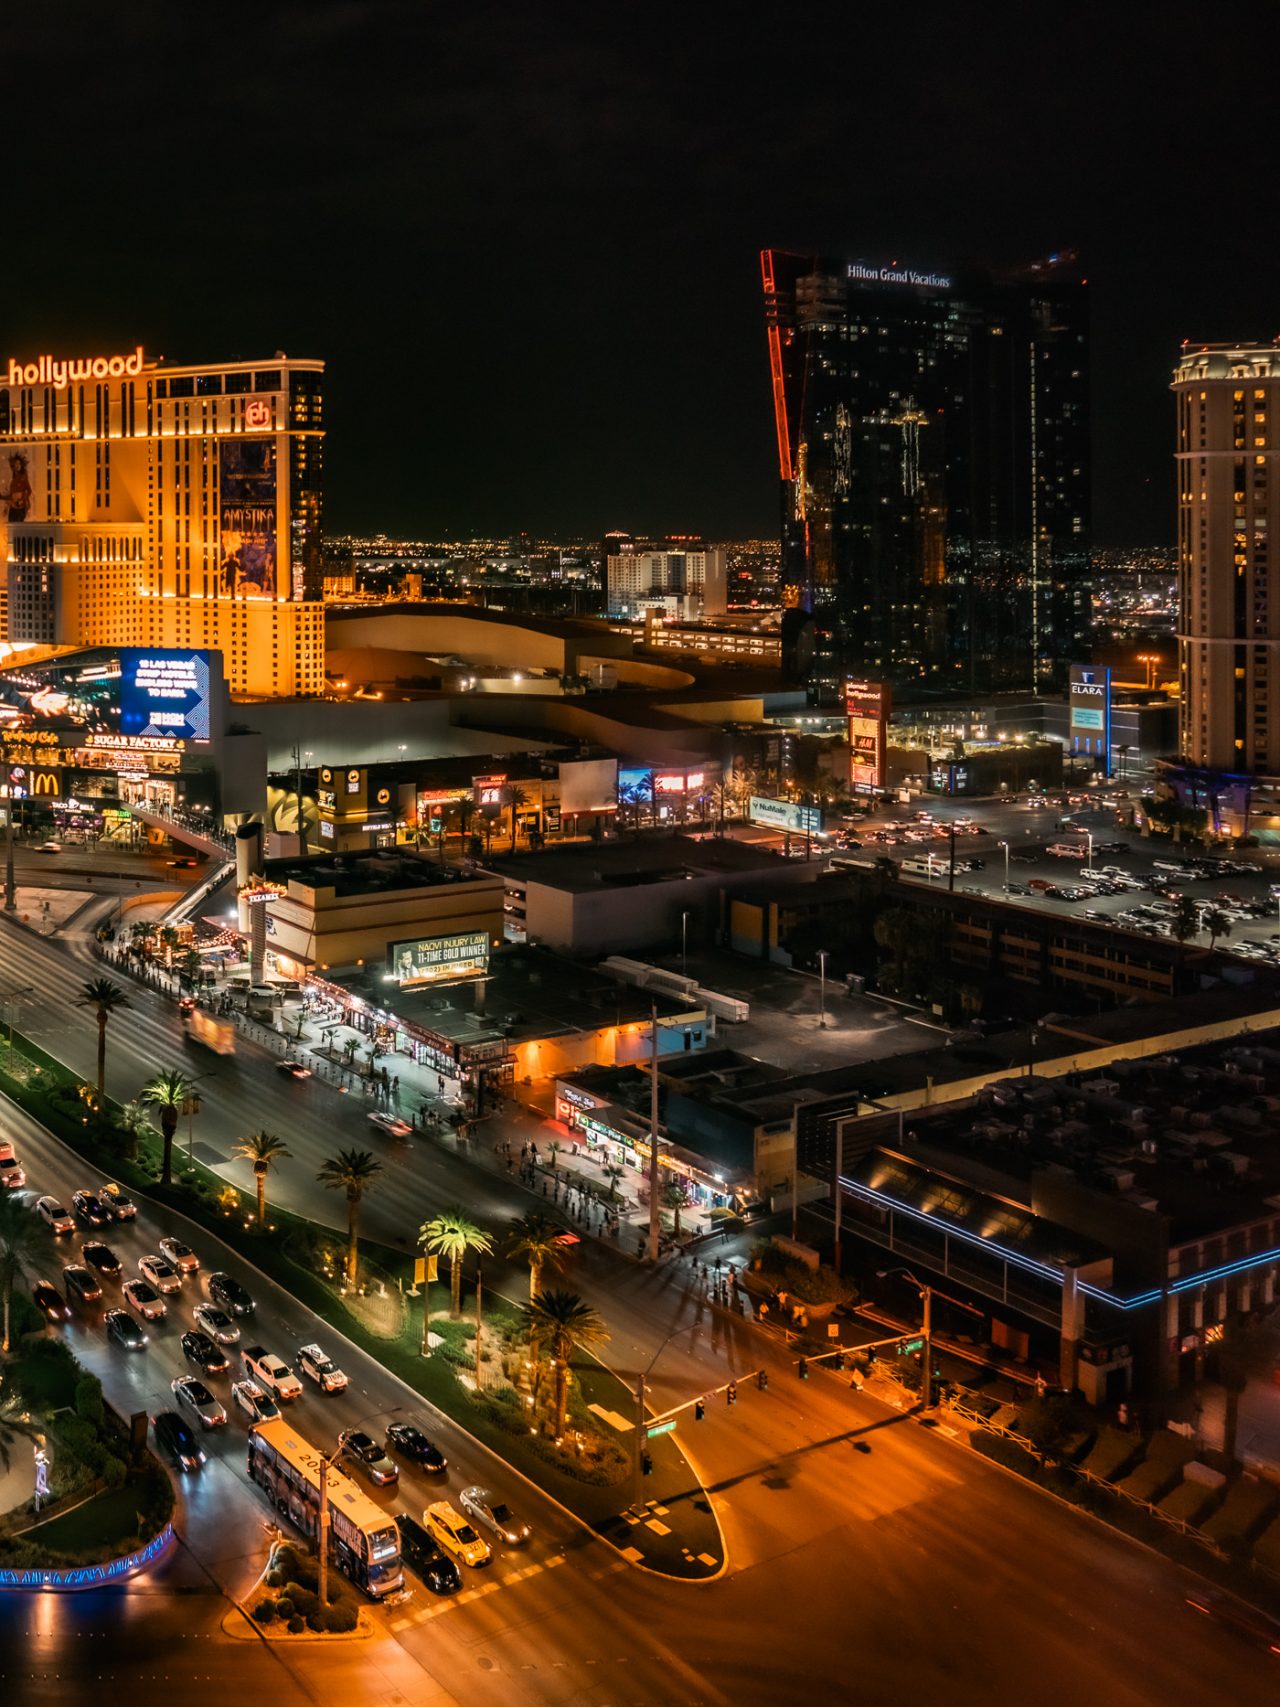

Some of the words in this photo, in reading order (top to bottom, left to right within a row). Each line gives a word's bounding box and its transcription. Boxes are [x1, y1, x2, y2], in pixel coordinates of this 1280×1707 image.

[847, 265, 878, 280] Hilton
[880, 268, 908, 283] Grand
[909, 271, 950, 288] Vacations
[8, 347, 143, 390] hollywood
[223, 508, 274, 525] AMYSTIKA
[1071, 685, 1103, 696] ELARA
[38, 730, 59, 745] Cafe
[93, 734, 128, 747] SUGAR
[129, 736, 176, 749] FACTORY
[52, 801, 68, 809] TACO
[79, 803, 95, 812] BELL
[101, 808, 132, 818] SUBWAY
[759, 802, 787, 816] NuMale
[443, 938, 469, 950] INJURY
[470, 935, 486, 945] LAW
[417, 949, 441, 964] 11-TIME
[443, 946, 459, 960] GOLD
[460, 943, 486, 958] WINNER
[299, 1453, 340, 1489] 203
